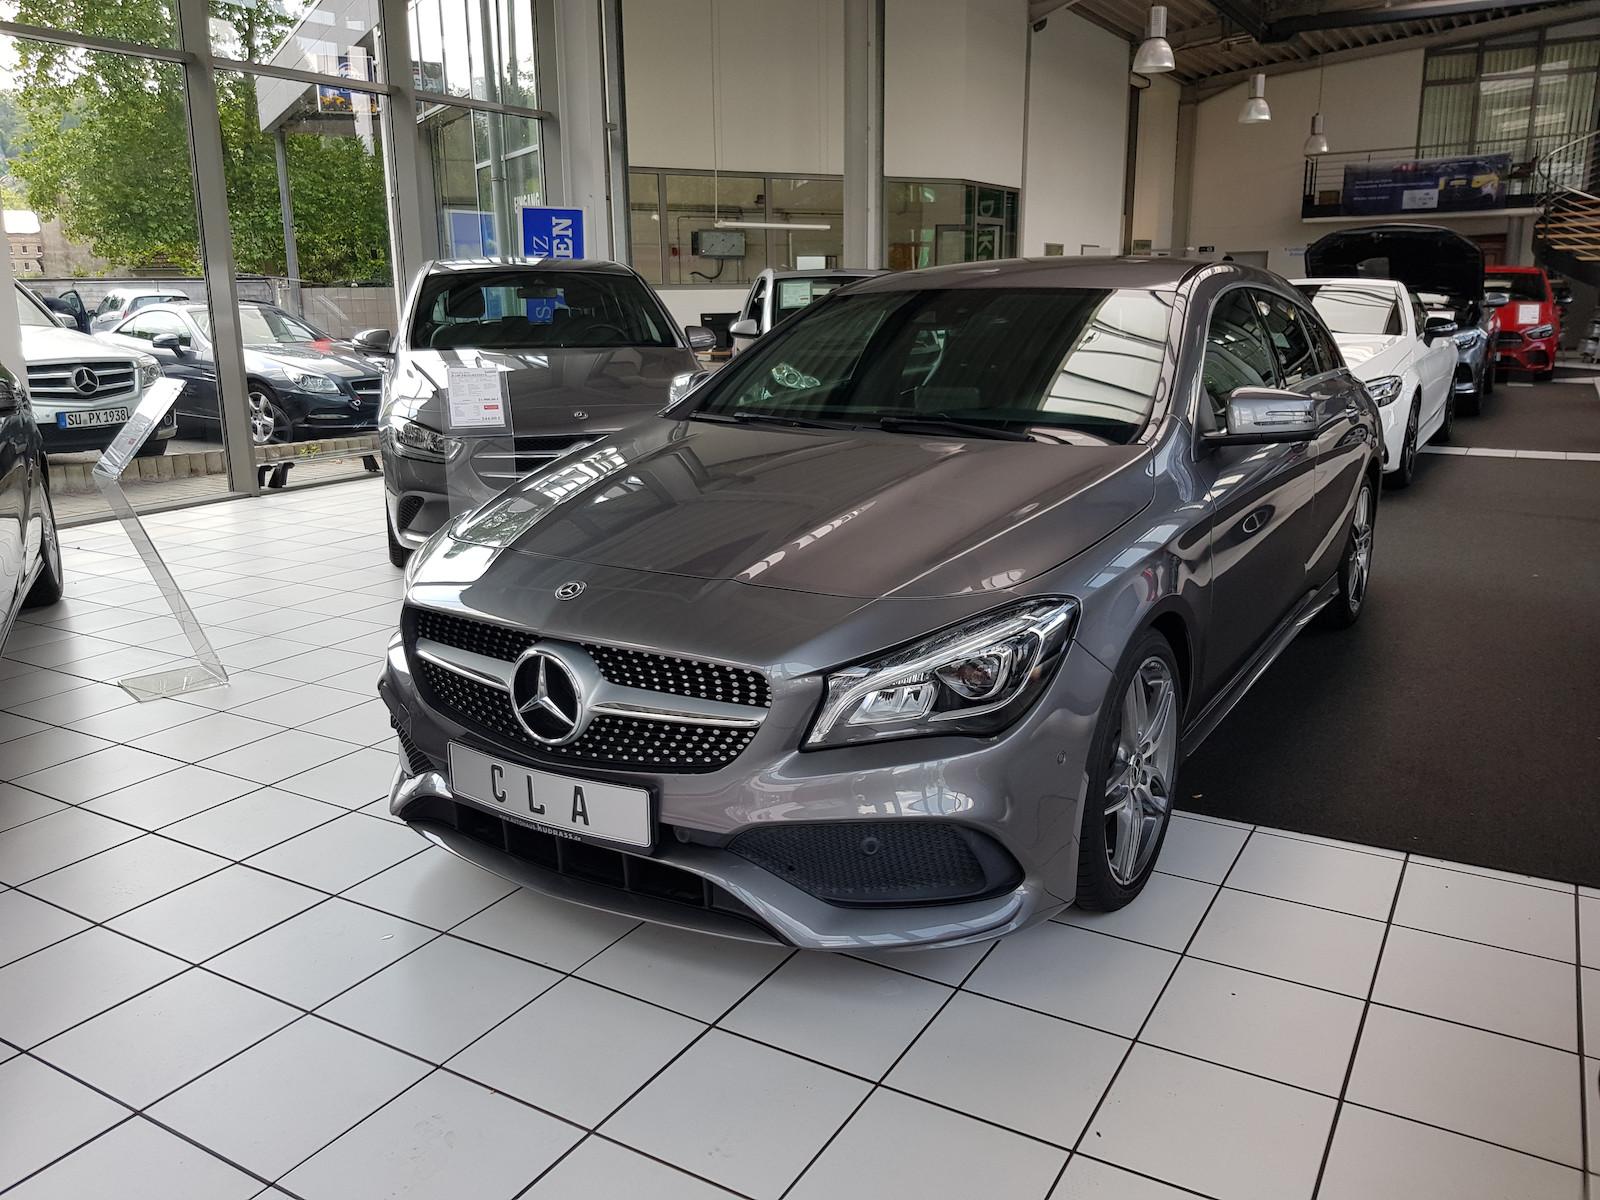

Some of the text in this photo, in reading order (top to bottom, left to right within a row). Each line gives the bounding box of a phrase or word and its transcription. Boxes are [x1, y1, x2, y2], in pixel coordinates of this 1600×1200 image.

[68, 409, 126, 425] SU PX 1938
